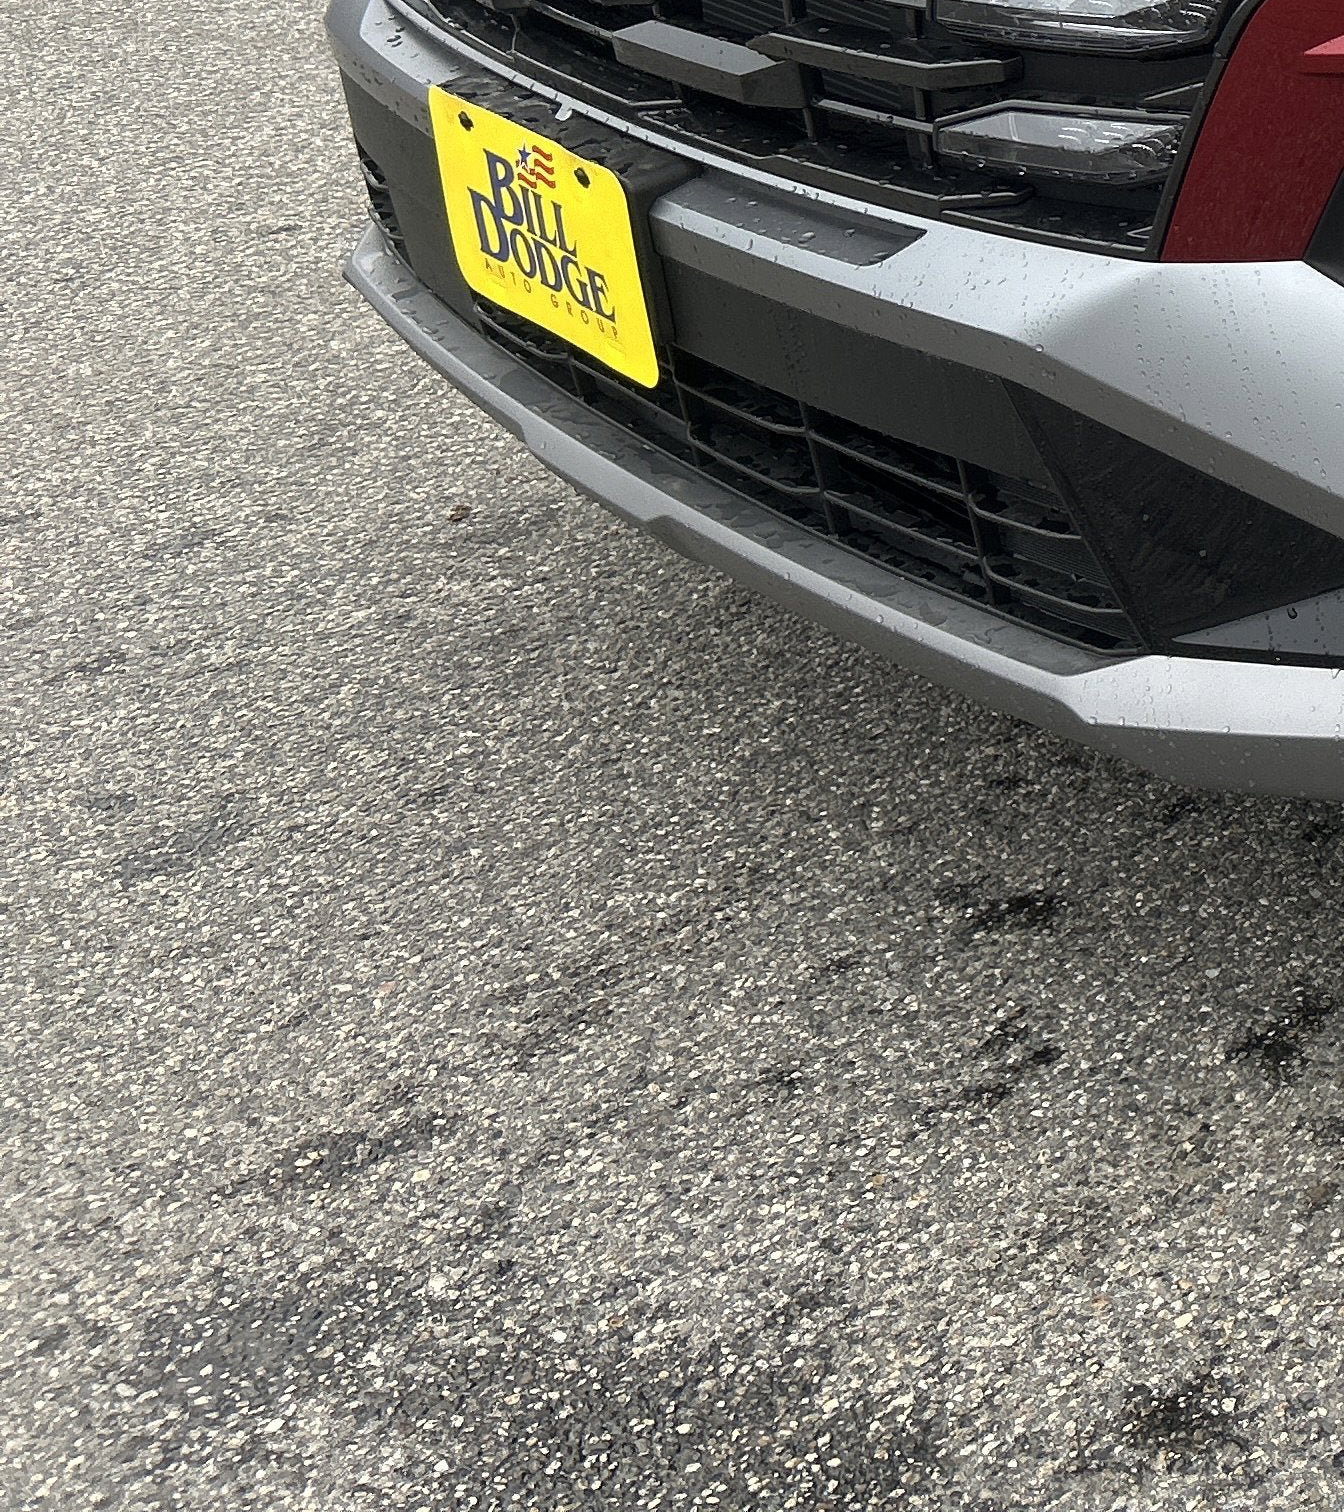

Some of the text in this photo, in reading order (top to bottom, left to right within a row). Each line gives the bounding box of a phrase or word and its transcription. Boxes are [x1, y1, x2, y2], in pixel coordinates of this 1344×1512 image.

[467, 186, 616, 324] DODGE
[483, 148, 577, 258] BILL
[485, 257, 619, 341] AUTO GROUP
